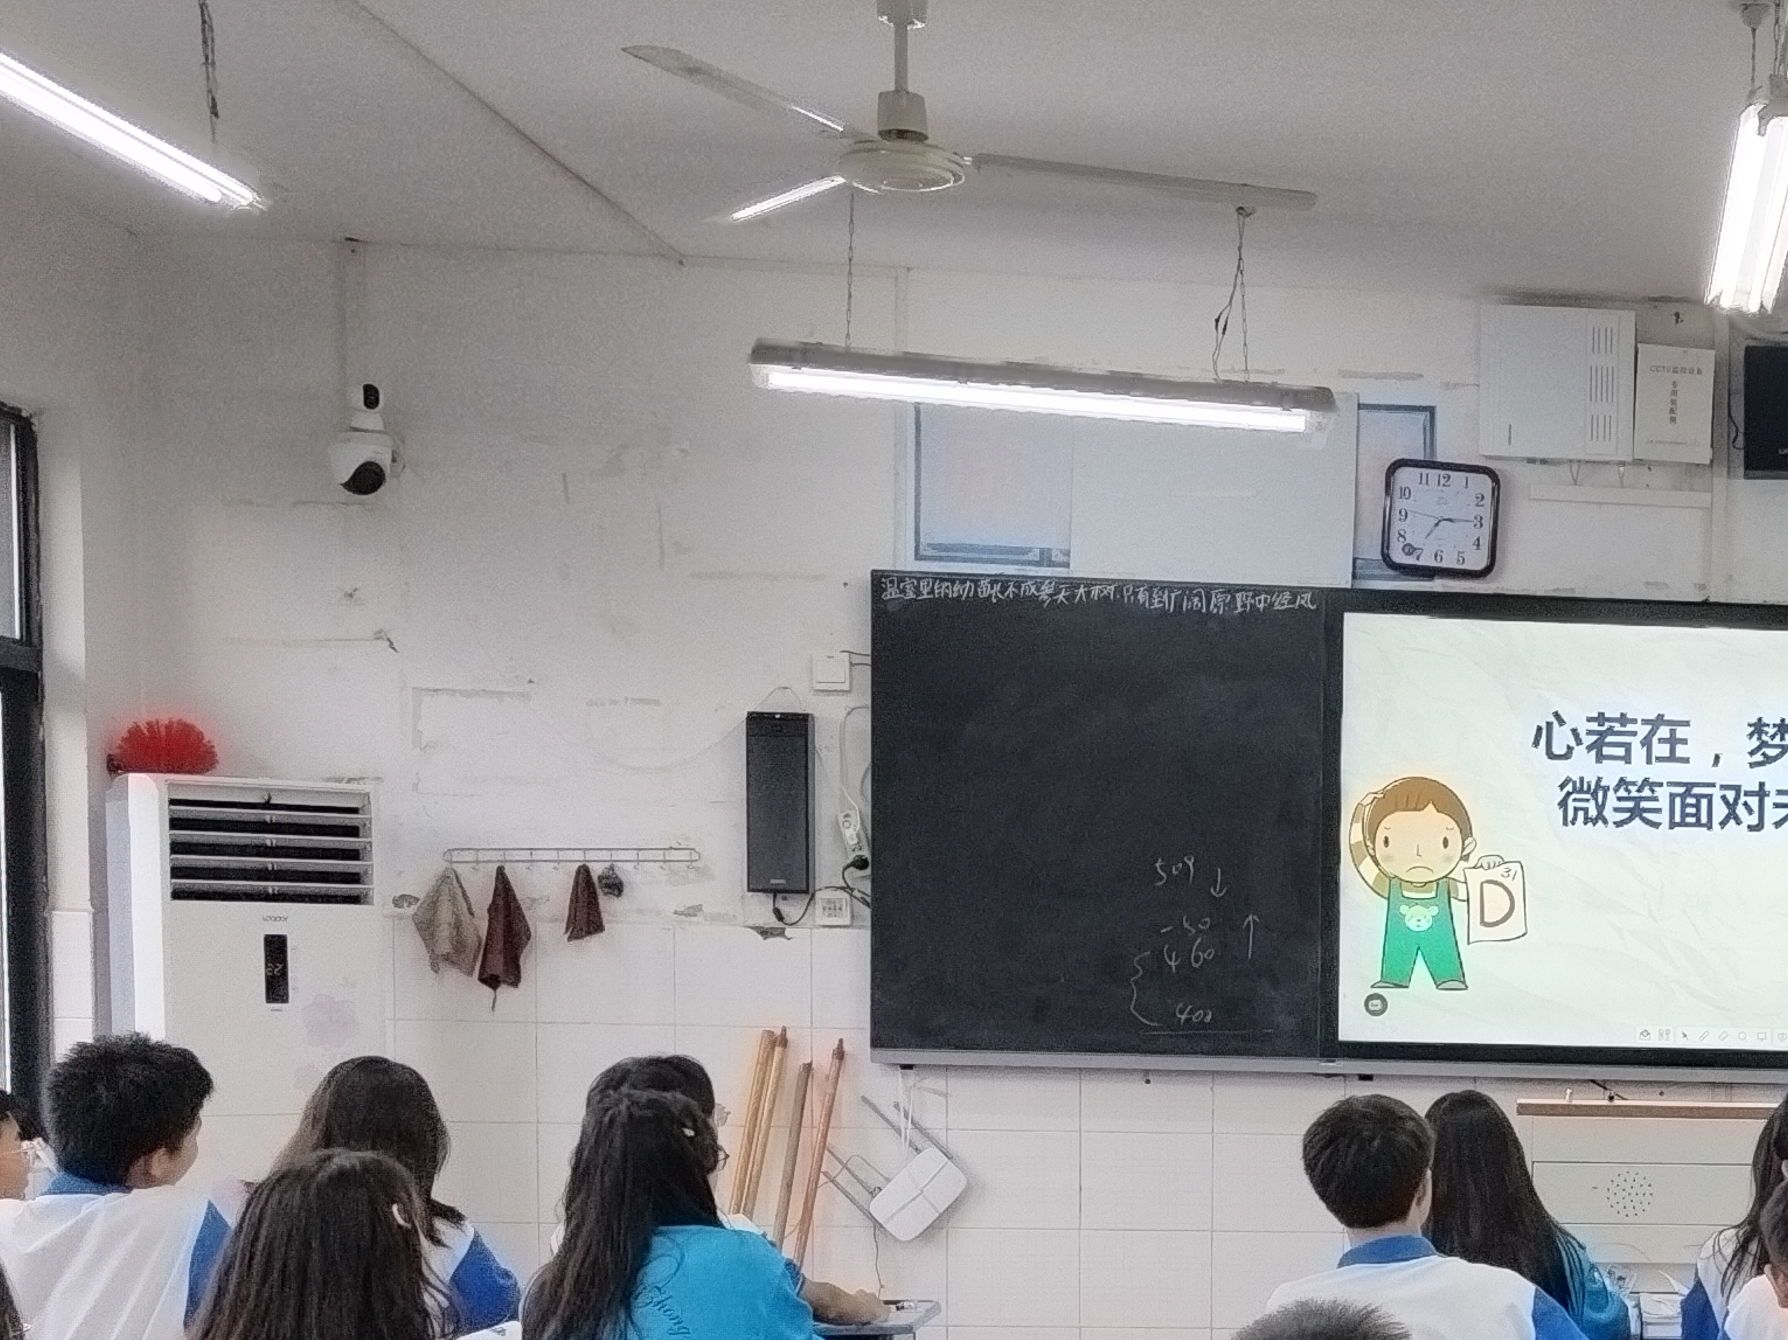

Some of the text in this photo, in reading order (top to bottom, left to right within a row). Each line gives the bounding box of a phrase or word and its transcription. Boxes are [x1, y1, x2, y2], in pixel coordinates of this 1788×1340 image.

[1418, 472, 1429, 486] 11
[1437, 473, 1451, 488] 12
[1398, 486, 1412, 501] 10
[1474, 493, 1485, 508] 2
[1398, 508, 1408, 522] 9
[1473, 514, 1484, 529] 3
[1397, 529, 1407, 543] 8
[1472, 536, 1482, 551] 4
[1414, 547, 1424, 562] 7
[1434, 549, 1444, 564] 6
[1456, 550, 1466, 565] 5
[1479, 879, 1516, 928] D
